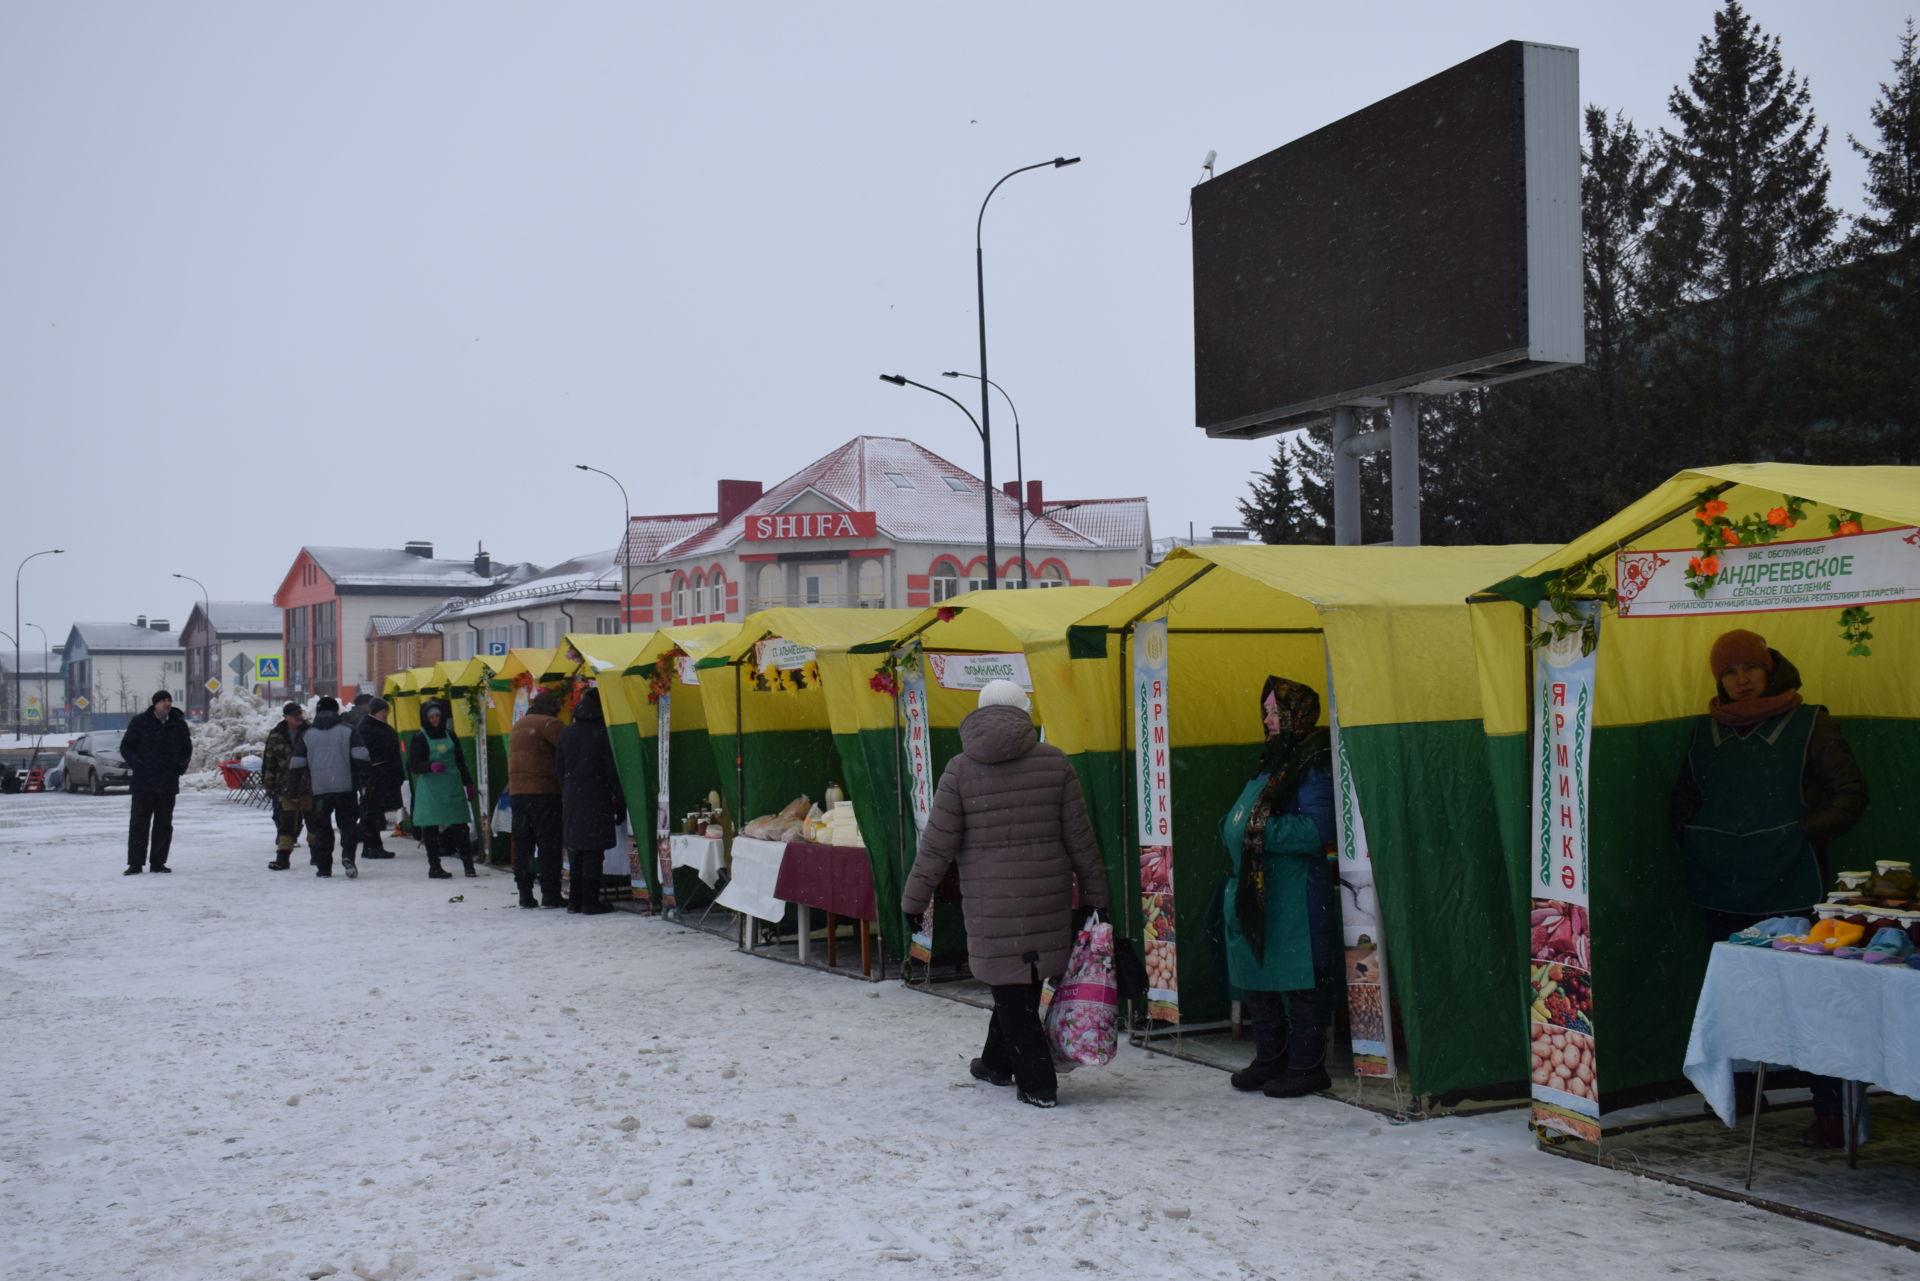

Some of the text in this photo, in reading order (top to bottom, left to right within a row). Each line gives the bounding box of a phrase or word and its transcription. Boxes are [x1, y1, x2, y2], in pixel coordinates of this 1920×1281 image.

[757, 514, 859, 539] SHIFA
[1747, 545, 1826, 561] ВАС ОБСЛУЖИВАЕТ
[1717, 555, 1855, 587] АНДРЕЕВСКОЕ
[1668, 587, 1905, 610] НУРЛАТСКОГО МУНИЦИПАЛЬНОГО РАЙОНА РЕСПУБЛИКИ ТАТАРСТАН
[1732, 581, 1832, 597] СЕЛЬСКОЕ ПОСЕЛЕНИЕ
[908, 690, 927, 814] ЯРМАРКА
[1551, 682, 1576, 890] ЯРМИНКӘ
